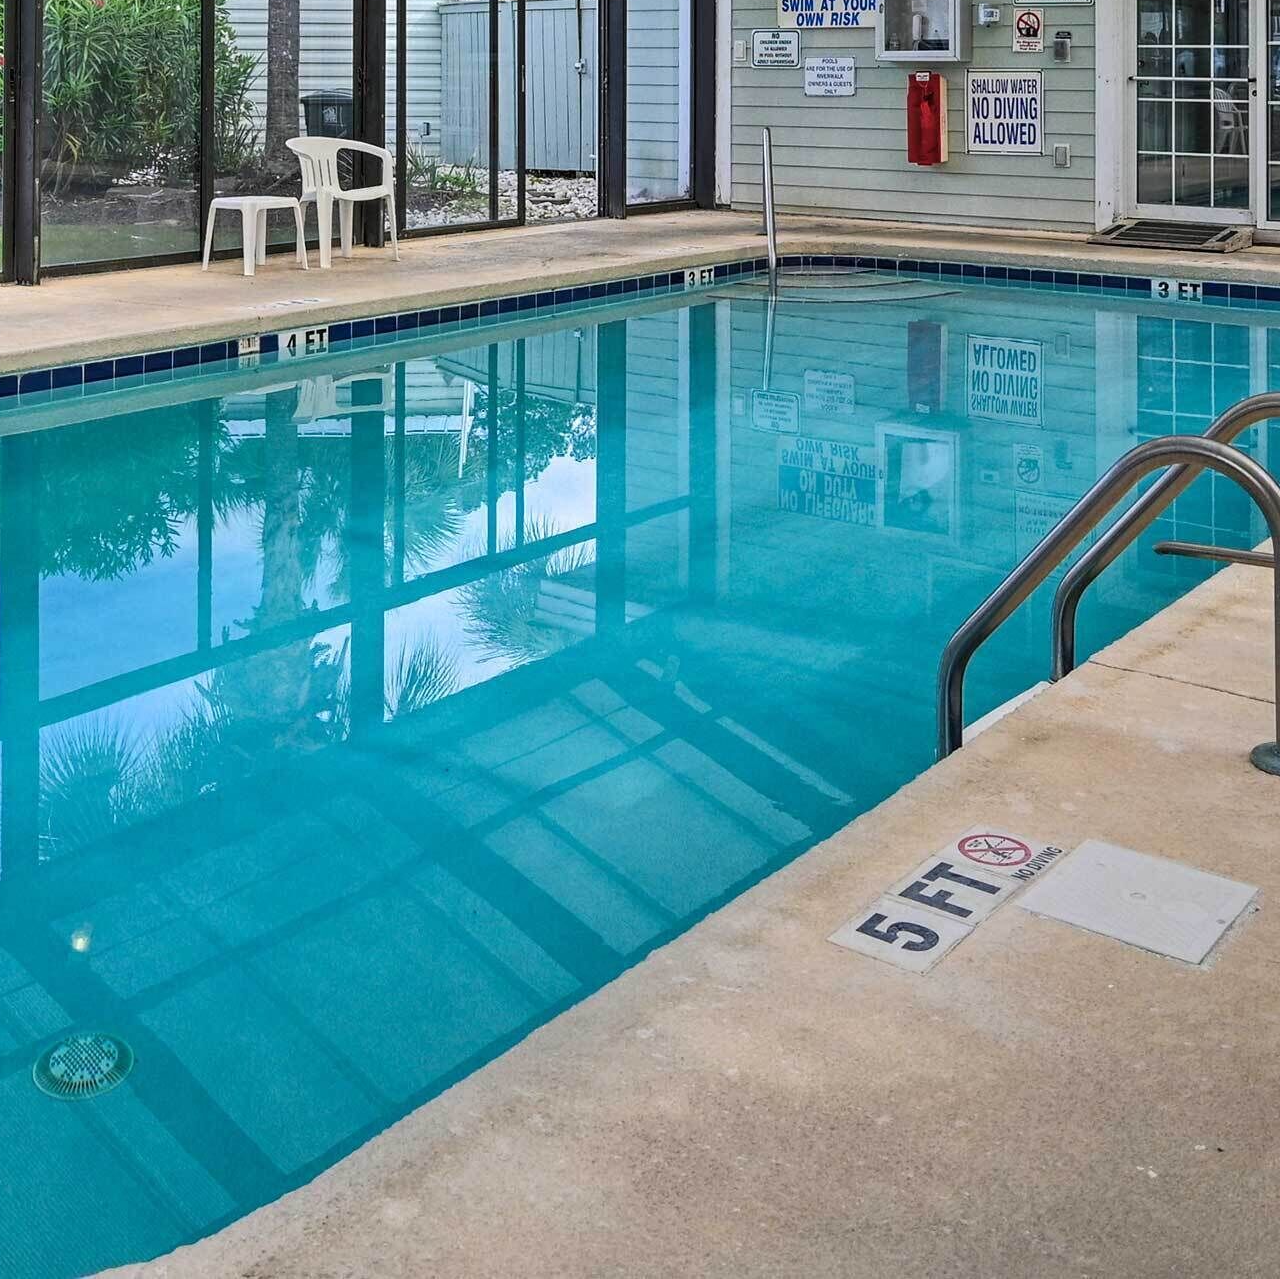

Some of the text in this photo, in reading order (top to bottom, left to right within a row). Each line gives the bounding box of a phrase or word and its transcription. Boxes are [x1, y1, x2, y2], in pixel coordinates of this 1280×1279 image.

[796, 12, 860, 26] OWN RISK
[972, 79, 1037, 94] SHALLOW WATER
[972, 97, 1037, 119] NO DIVING
[973, 122, 1036, 145] ALLOWED
[1010, 846, 1063, 882] NO DIVING
[856, 861, 1002, 952] 5 FT
